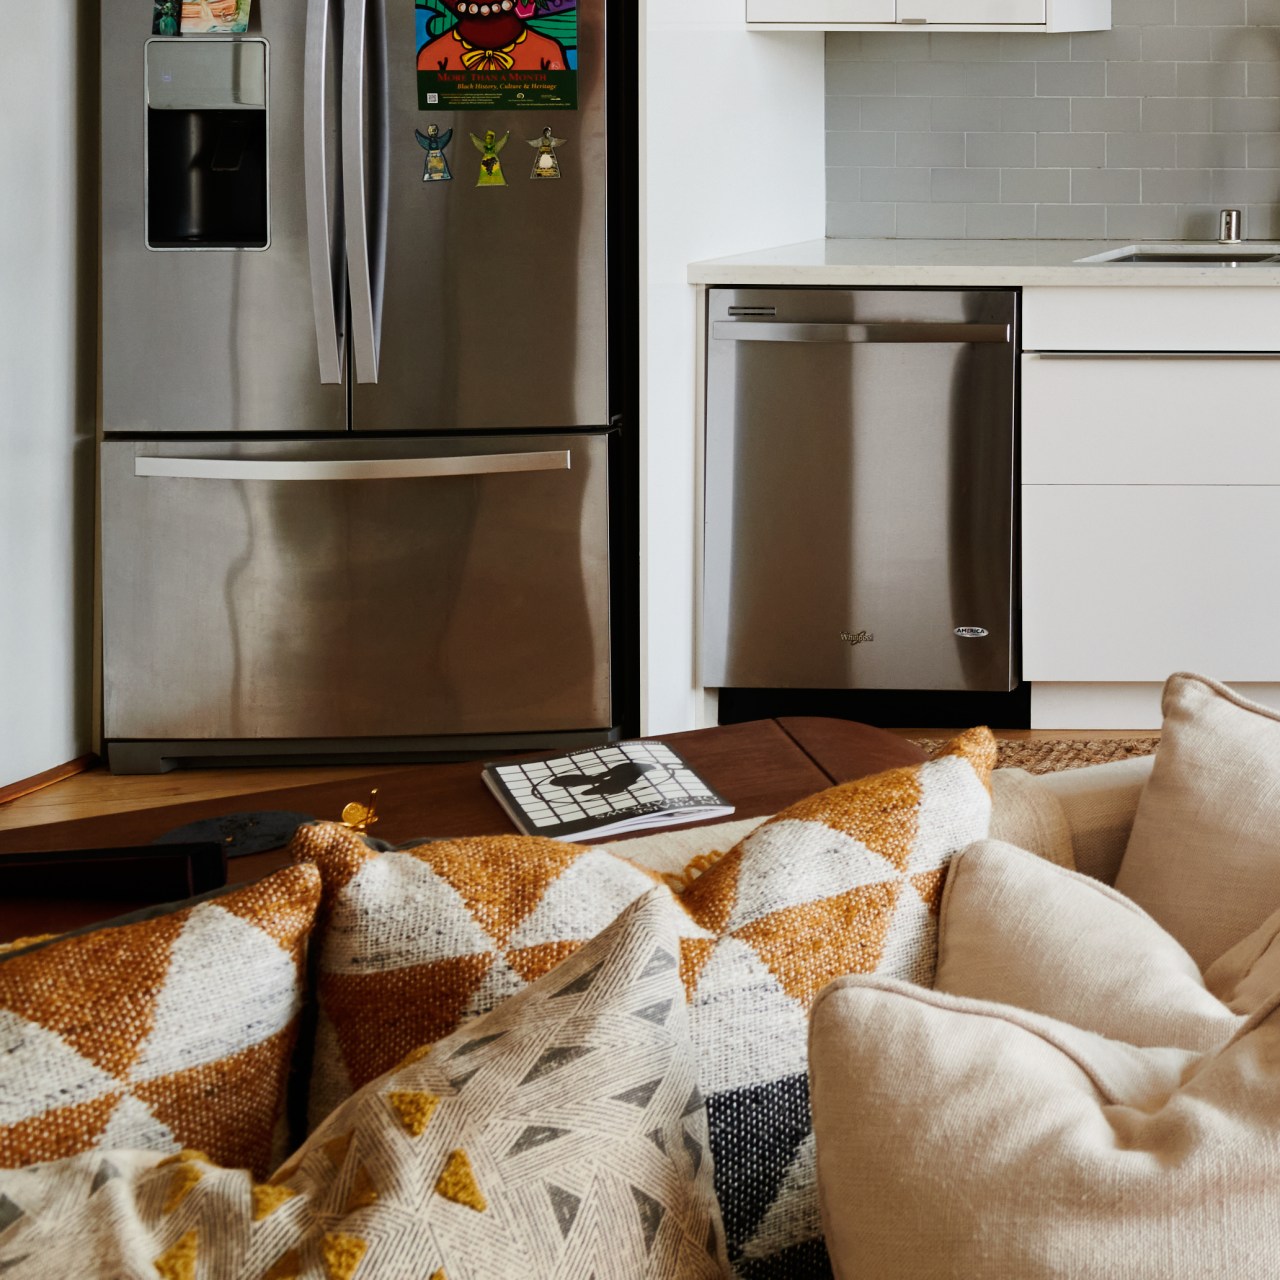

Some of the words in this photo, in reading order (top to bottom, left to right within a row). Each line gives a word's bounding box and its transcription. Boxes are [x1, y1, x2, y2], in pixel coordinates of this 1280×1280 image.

[437, 72, 466, 81] MORE
[471, 73, 498, 81] THAN
[508, 72, 547, 81] MONTH
[839, 631, 874, 644] Whirlpool
